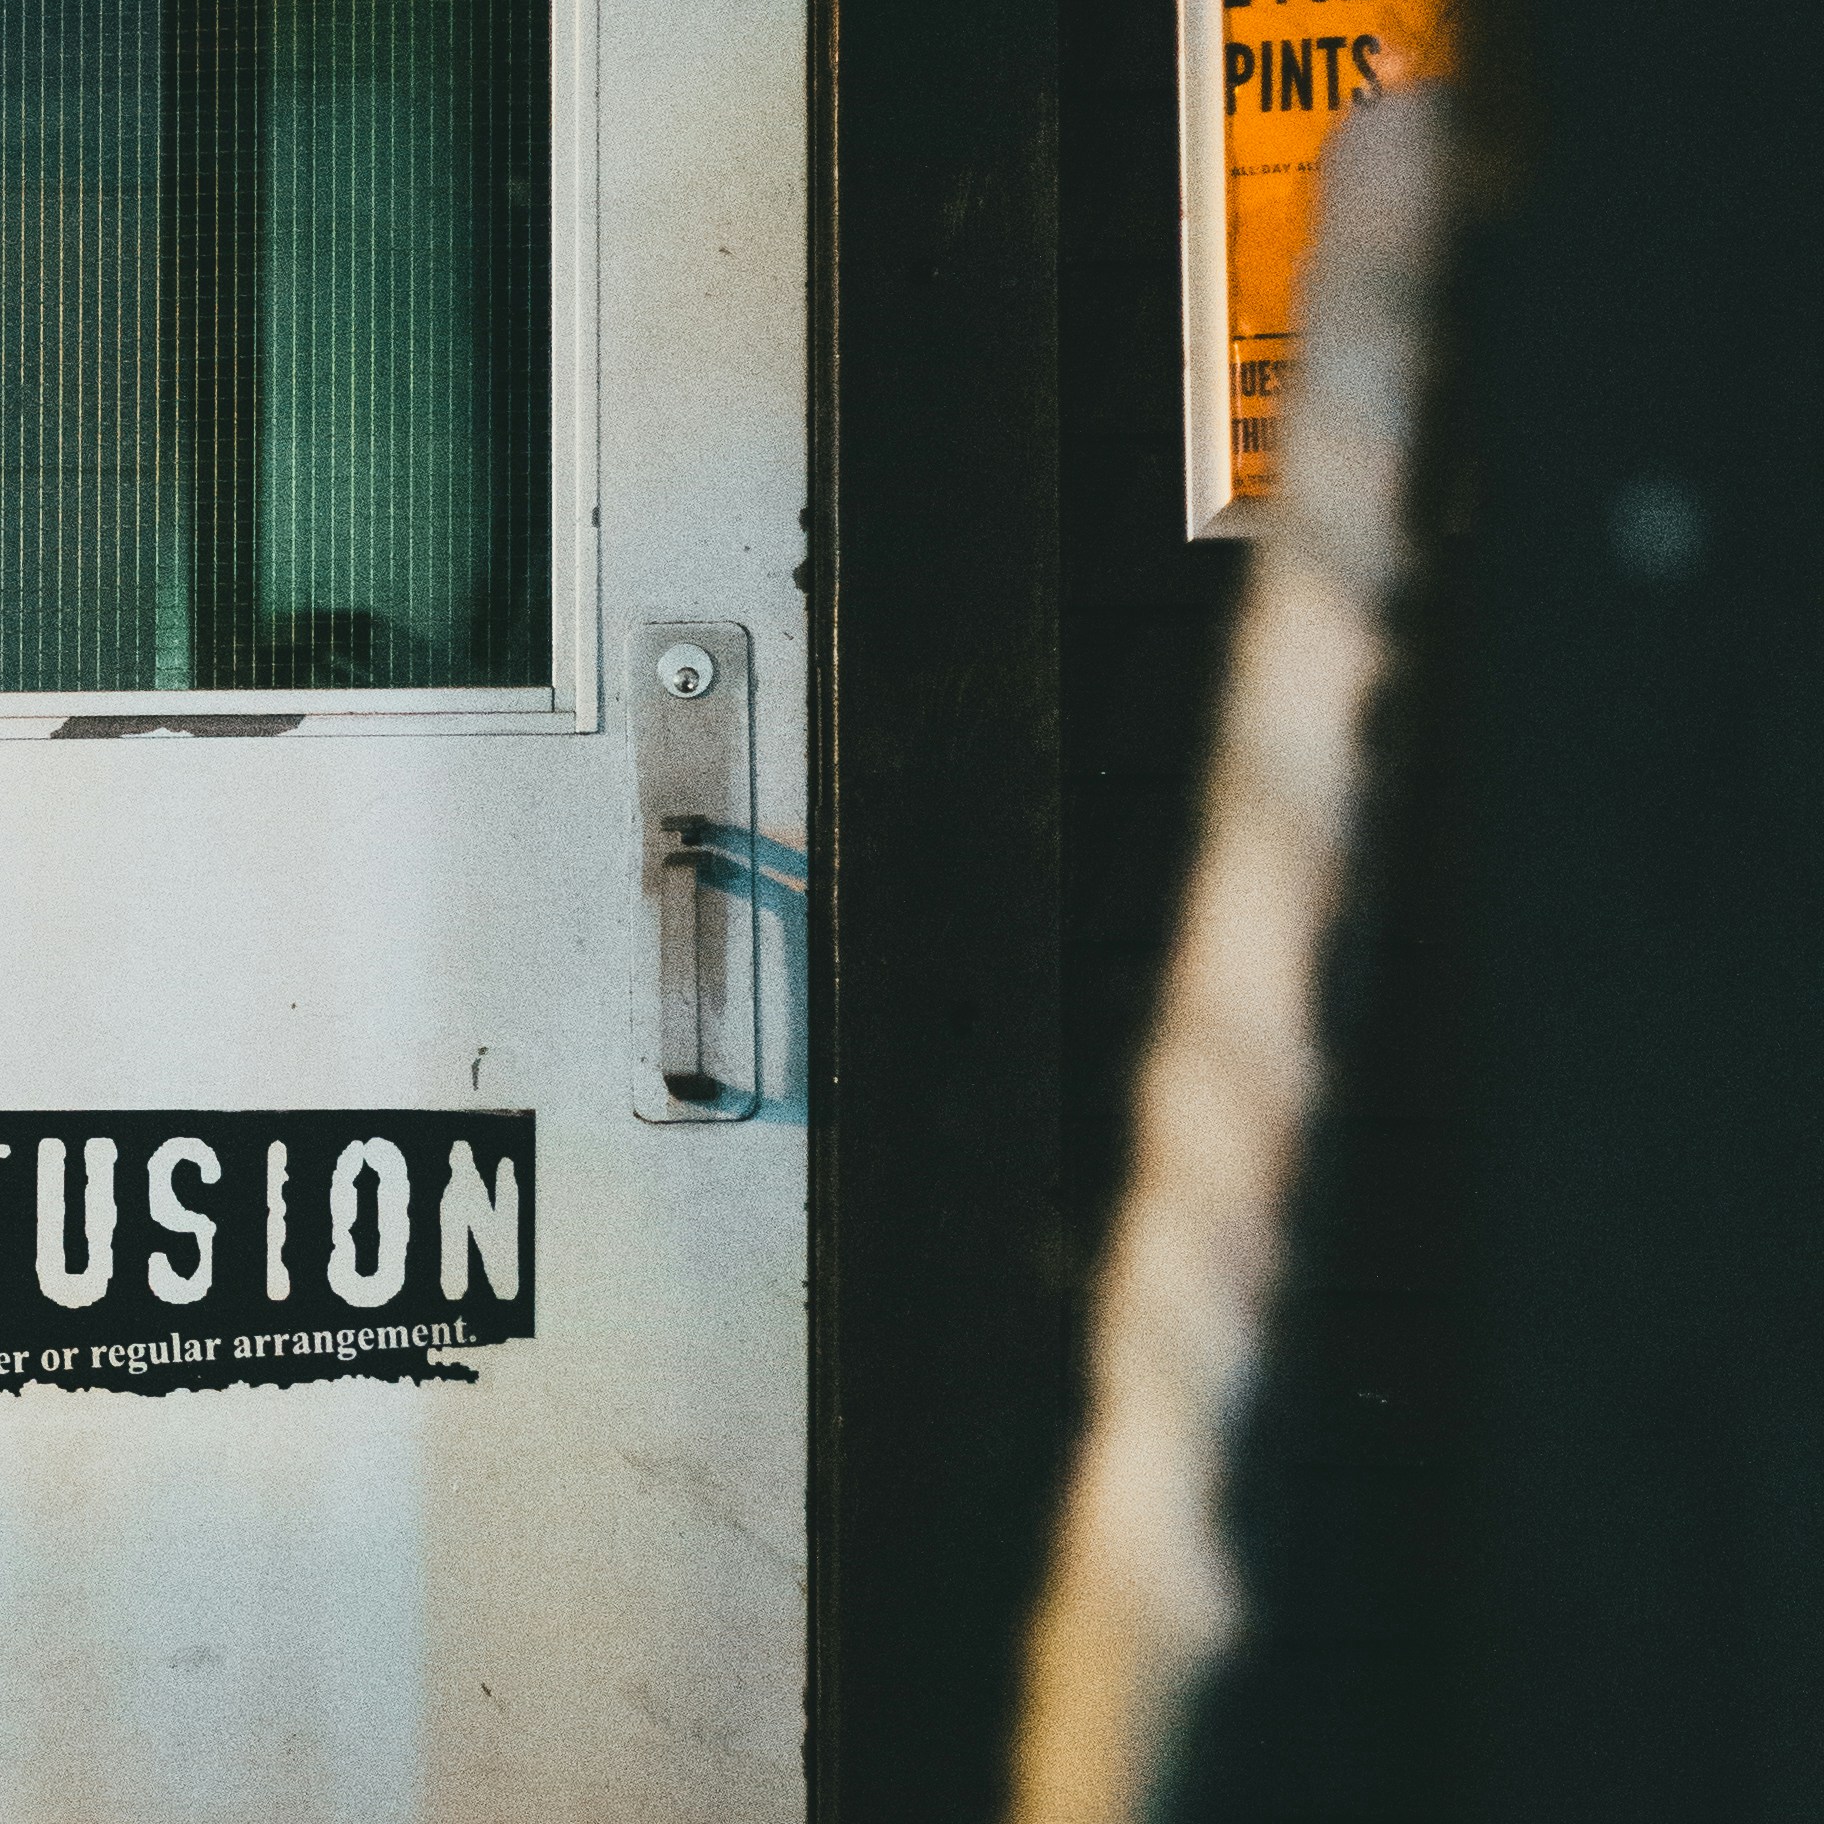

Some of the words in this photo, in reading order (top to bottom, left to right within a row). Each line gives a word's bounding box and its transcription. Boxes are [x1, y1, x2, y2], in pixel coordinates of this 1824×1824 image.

[1225, 34, 1382, 116] PINTS
[40, 1344, 77, 1372] or
[90, 1332, 222, 1376] regular
[233, 1316, 477, 1362] arrangement.
